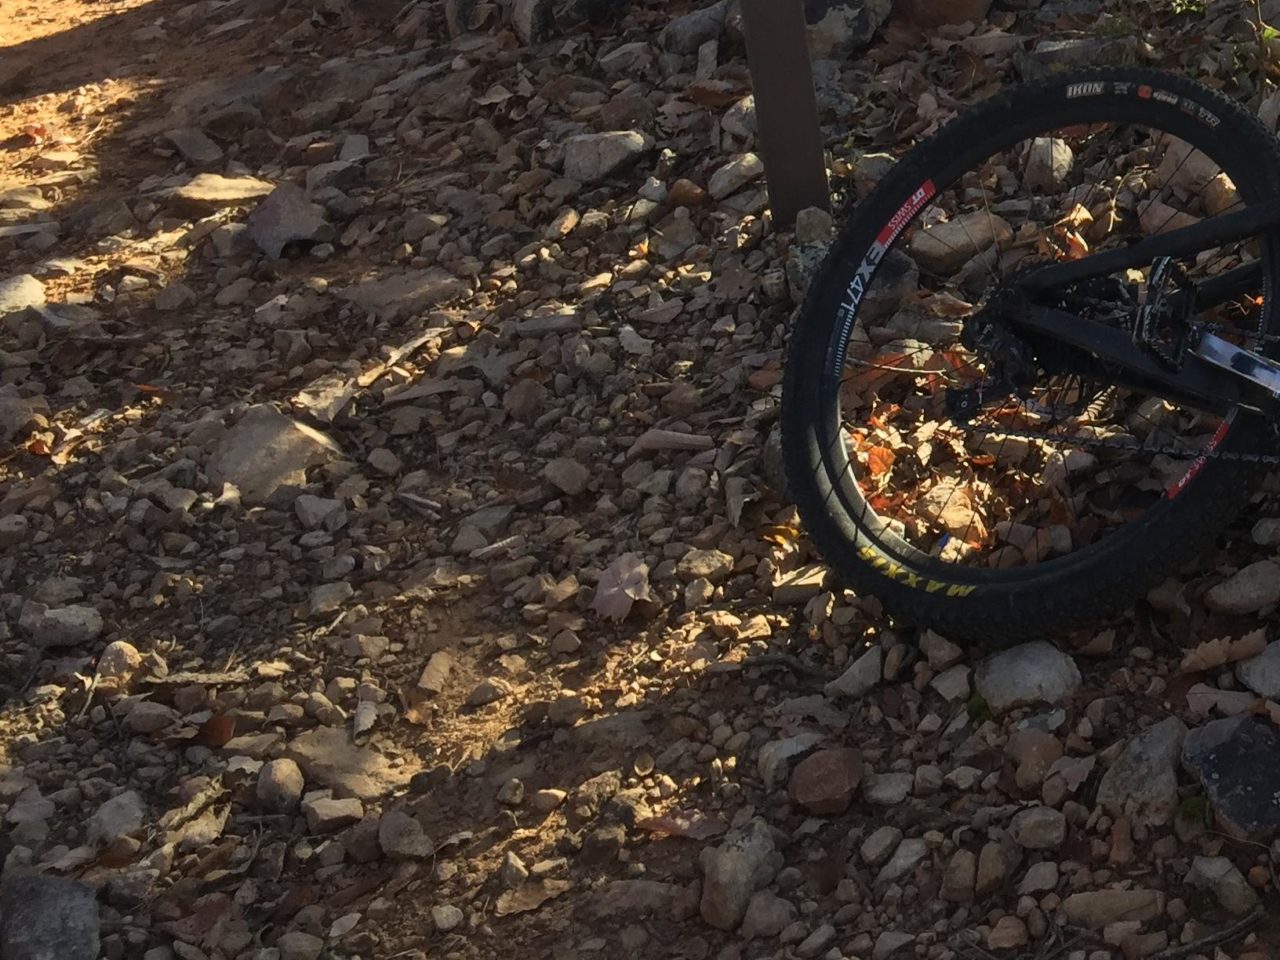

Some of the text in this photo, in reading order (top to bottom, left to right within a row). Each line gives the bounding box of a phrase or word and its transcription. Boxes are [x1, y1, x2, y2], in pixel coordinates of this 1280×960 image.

[1066, 81, 1104, 99] IKON
[887, 187, 925, 230] DT SWISS
[841, 240, 886, 312] EX471
[857, 546, 977, 597] MAXXIS
